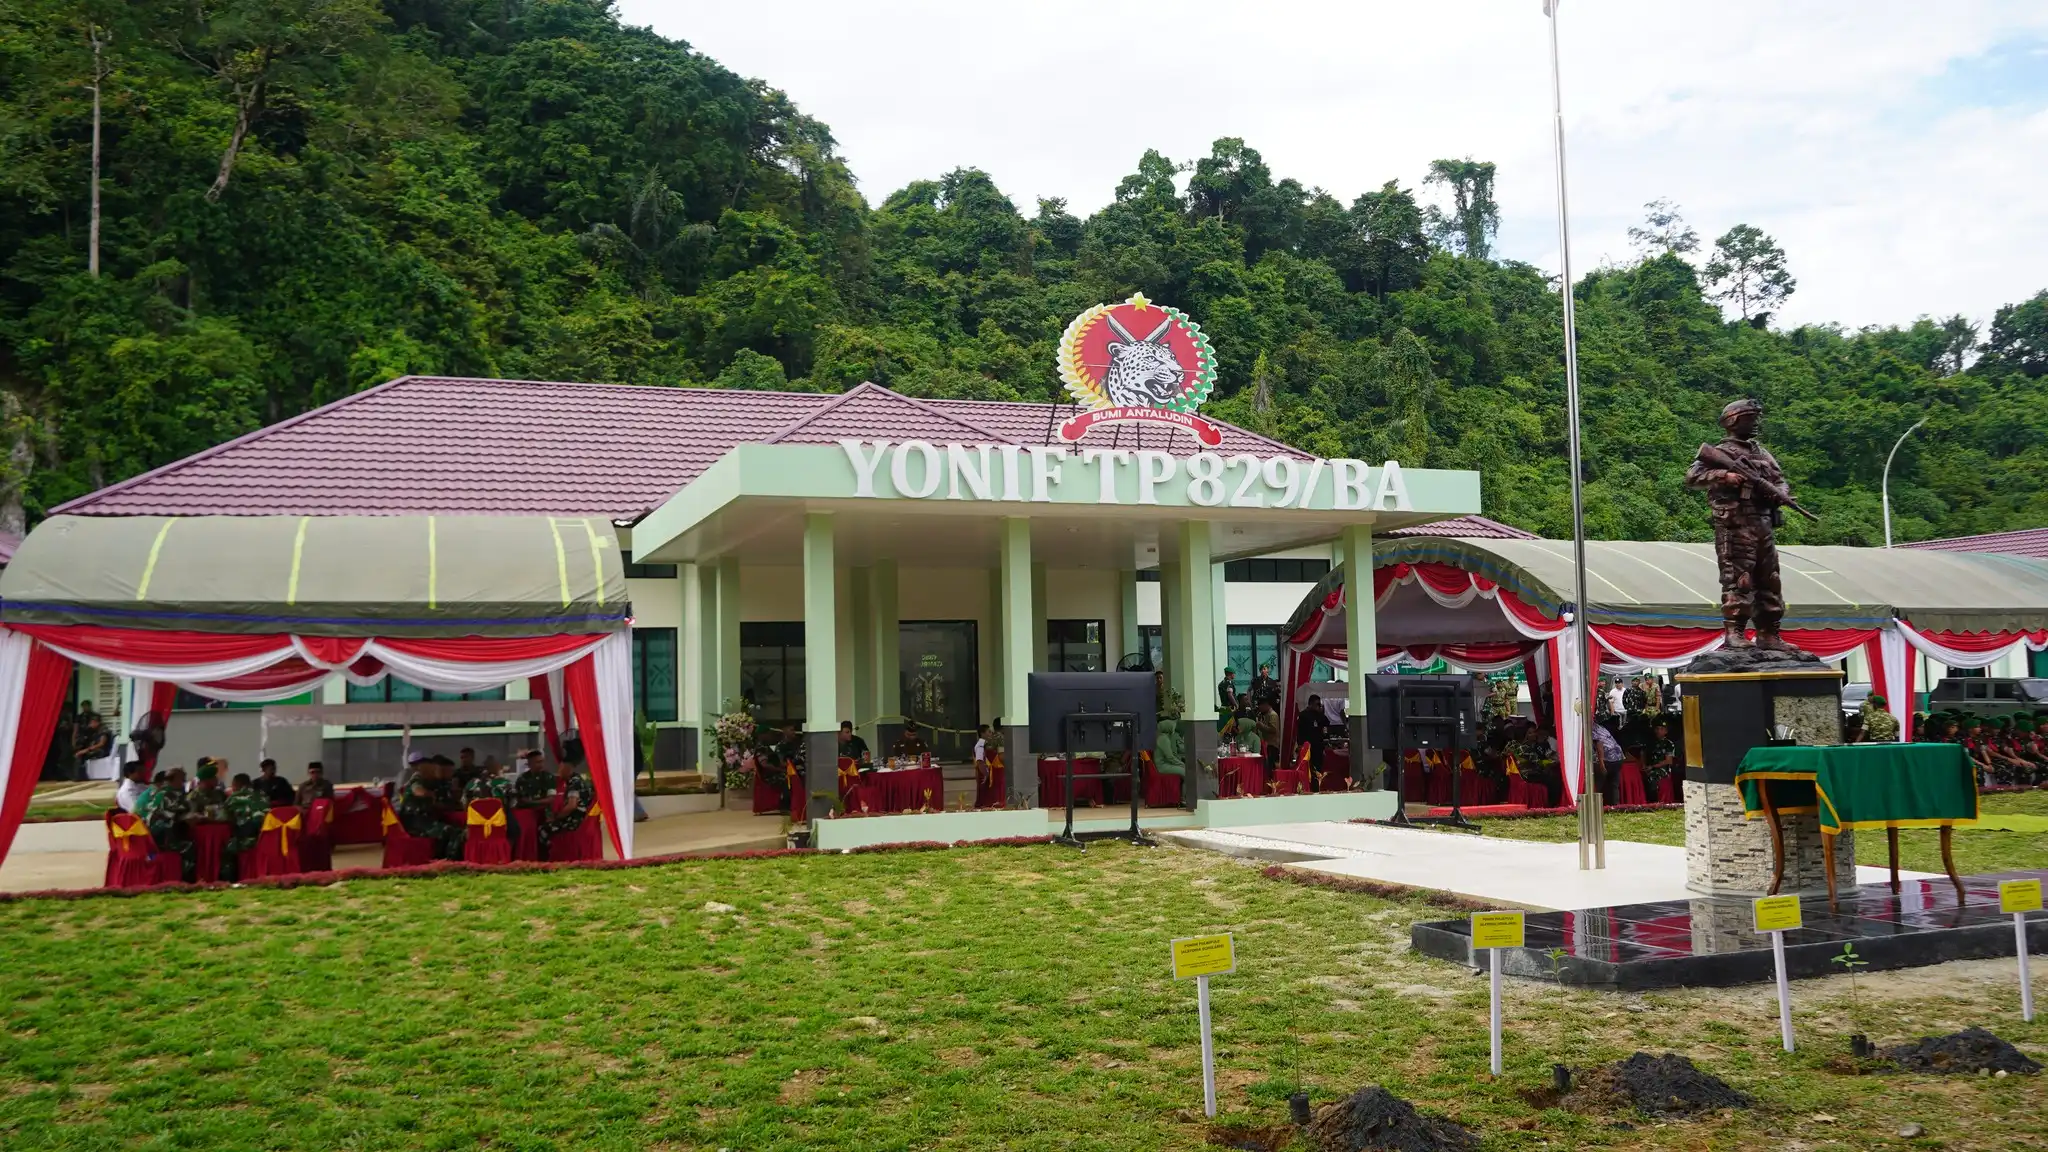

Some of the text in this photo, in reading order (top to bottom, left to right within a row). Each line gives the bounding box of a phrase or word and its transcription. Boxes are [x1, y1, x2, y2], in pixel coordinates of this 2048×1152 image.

[1092, 409, 1193, 426] BUMI ANTALUDIN
[838, 439, 1067, 503] YONIF
[1083, 448, 1177, 505] TP
